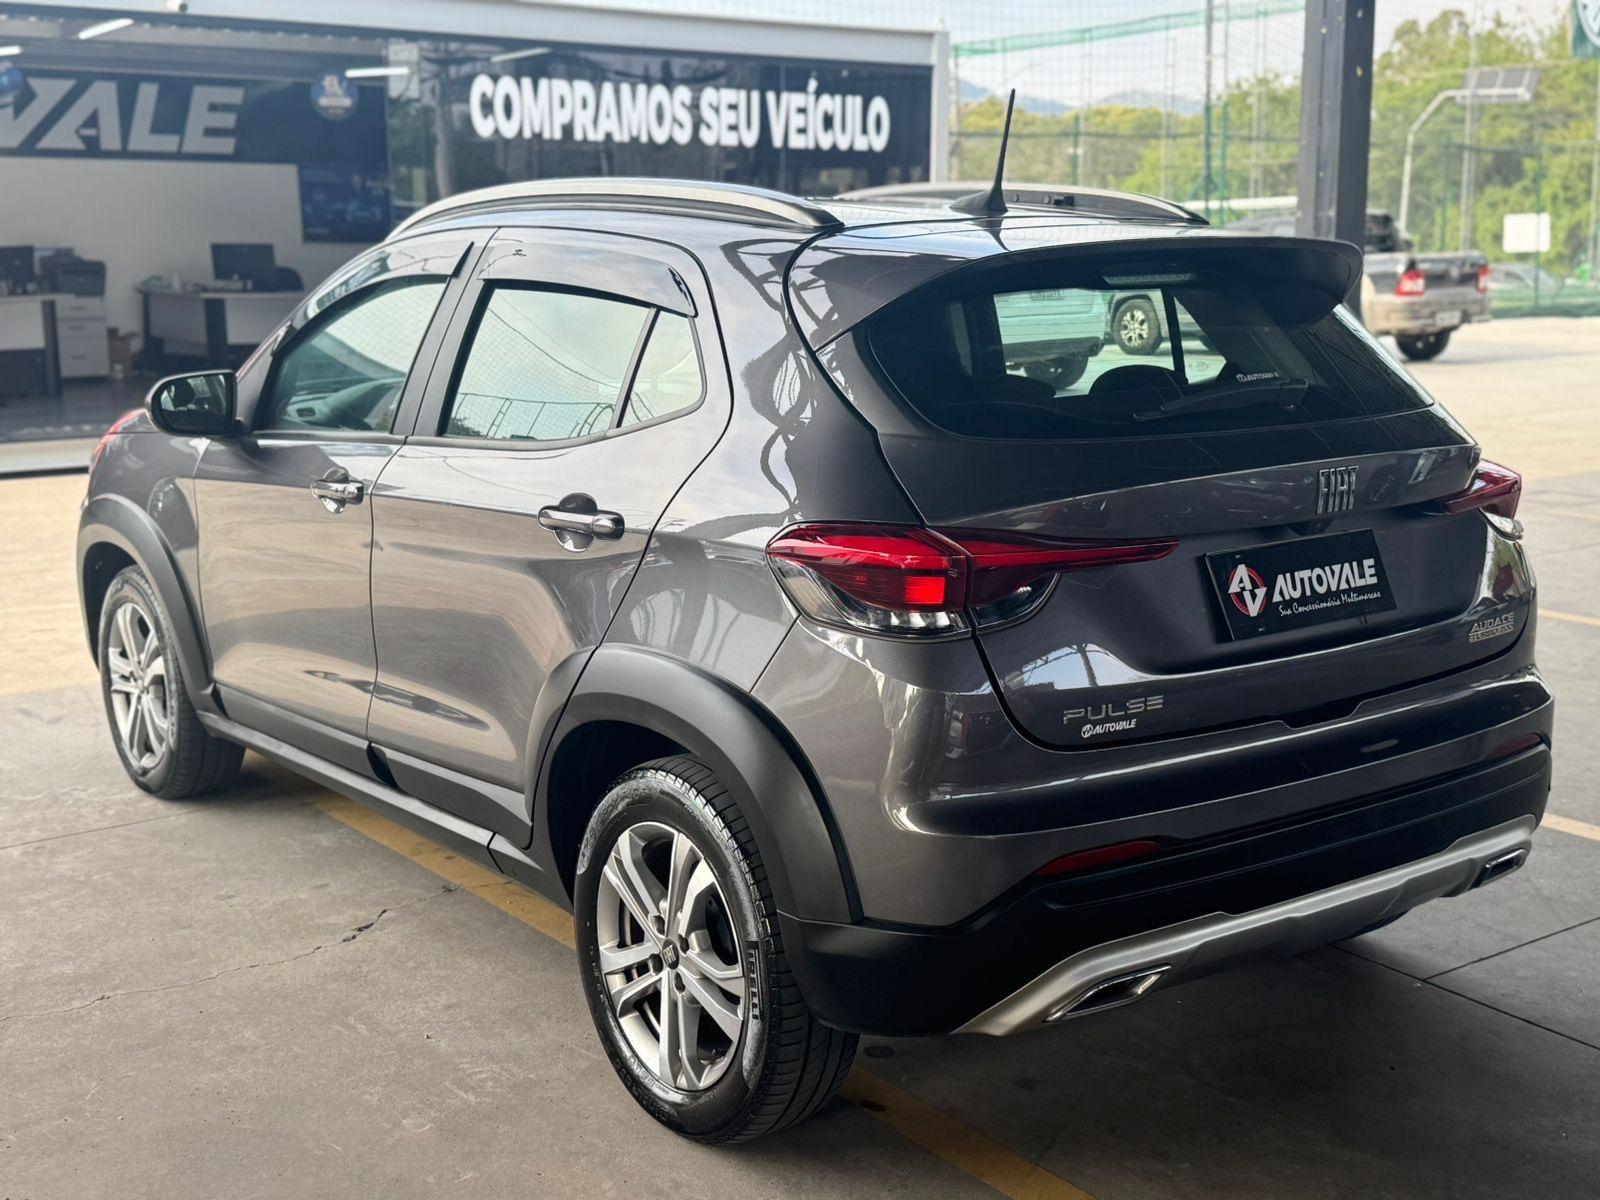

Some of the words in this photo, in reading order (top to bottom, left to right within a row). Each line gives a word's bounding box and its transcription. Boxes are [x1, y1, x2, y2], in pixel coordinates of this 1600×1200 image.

[469, 73, 693, 146] COMPRAMOS
[699, 86, 761, 149] SEU
[765, 78, 891, 153] VEÍCULO
[1315, 464, 1359, 514] FIAT
[1272, 557, 1378, 603] AUTOVALE
[1279, 604, 1292, 617] Sua
[1470, 611, 1514, 634] AUDACE
[1063, 695, 1164, 725] PULSE
[1092, 718, 1137, 735] AUTOVALE
